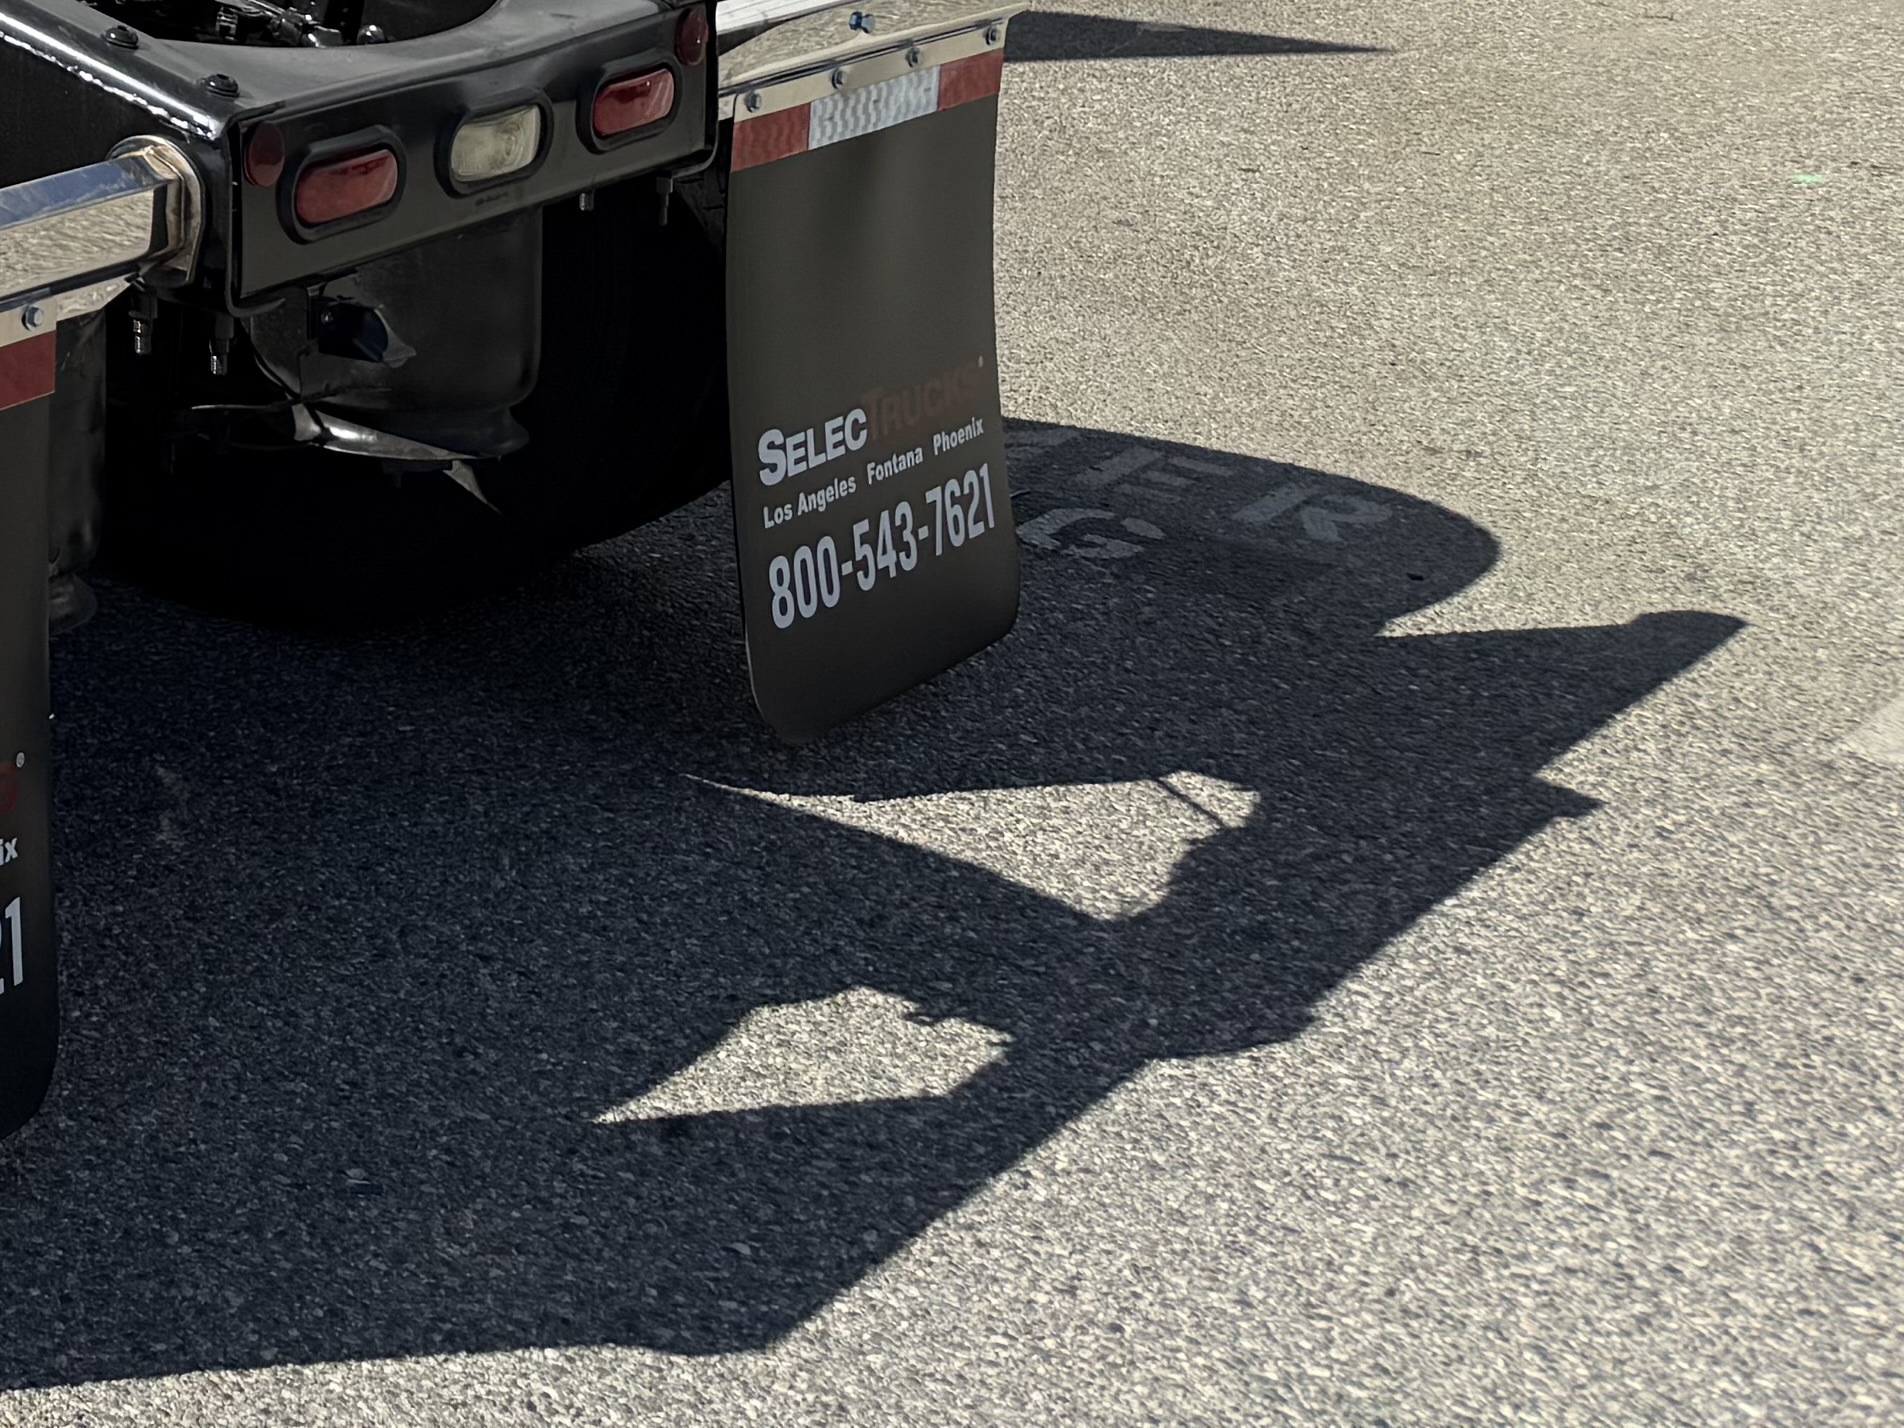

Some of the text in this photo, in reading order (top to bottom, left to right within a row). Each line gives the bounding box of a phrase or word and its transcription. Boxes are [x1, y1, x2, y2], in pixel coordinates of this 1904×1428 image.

[763, 416, 984, 529] Los Angeles Fontana Phoenix
[768, 463, 995, 629] 800-543-7621
